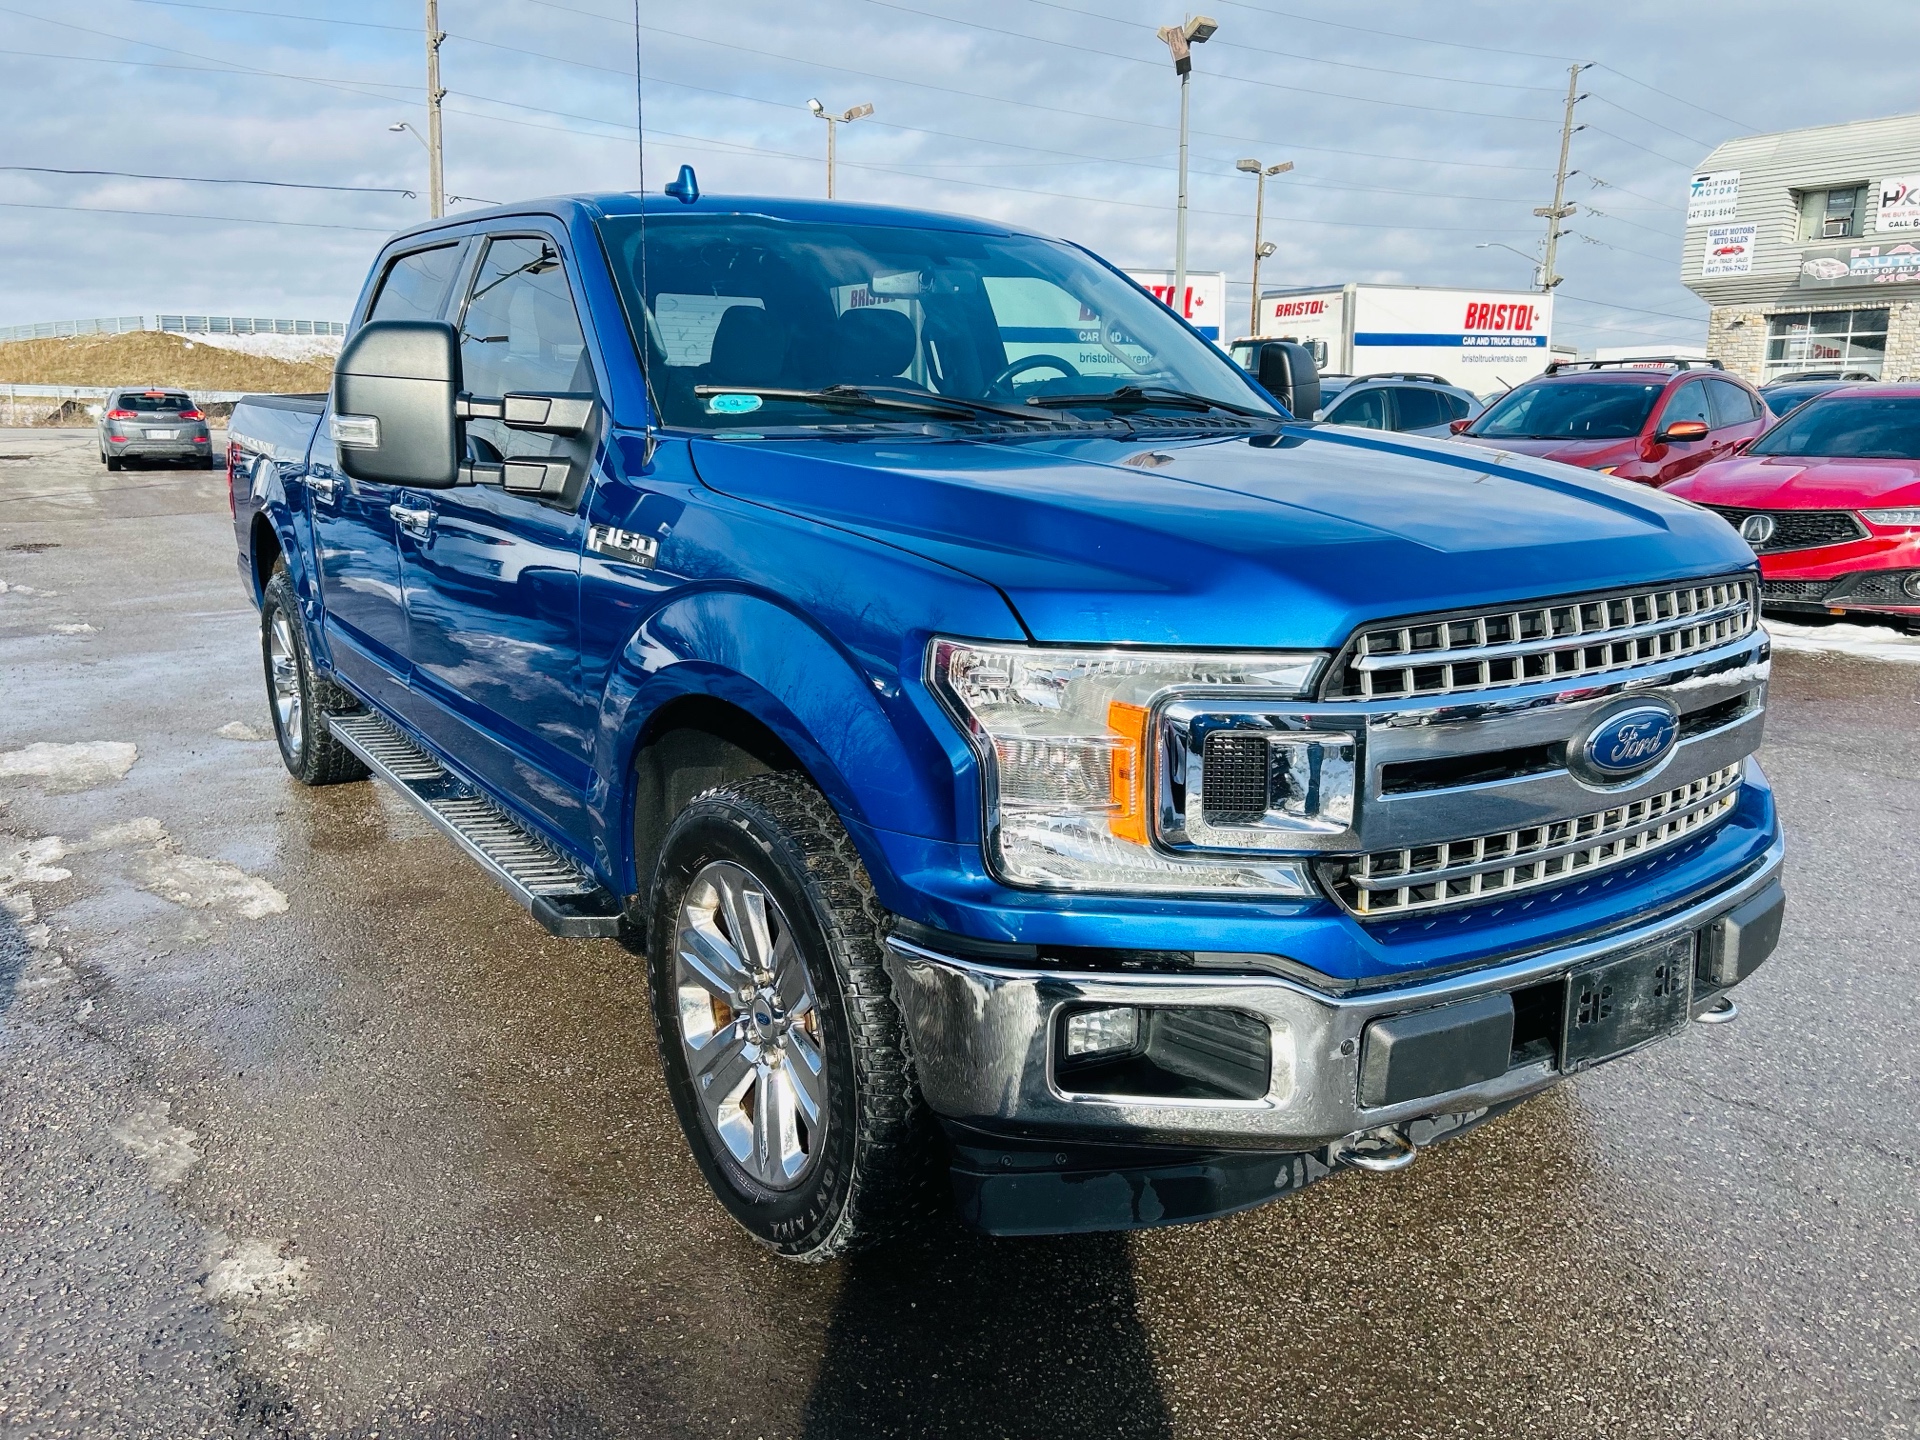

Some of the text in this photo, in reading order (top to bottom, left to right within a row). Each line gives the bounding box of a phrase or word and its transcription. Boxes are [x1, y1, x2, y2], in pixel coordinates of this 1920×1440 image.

[1706, 177, 1739, 188] FAIR TRADE
[1698, 185, 1739, 198] MOTORS
[1709, 226, 1755, 237] GREAT MOTORS
[1713, 235, 1749, 245] AUTO SALES
[1850, 264, 1916, 277] SALES OF ALL
[1275, 300, 1325, 318] BRISTOL
[1463, 302, 1535, 331] BRISTOL
[1079, 331, 1100, 342] CAR
[1462, 336, 1537, 347] CAR AND TRUCK RENTALS
[1461, 354, 1528, 363] bristoltruckrentals.com
[630, 553, 648, 565] XLT
[1610, 721, 1664, 763] Ford
